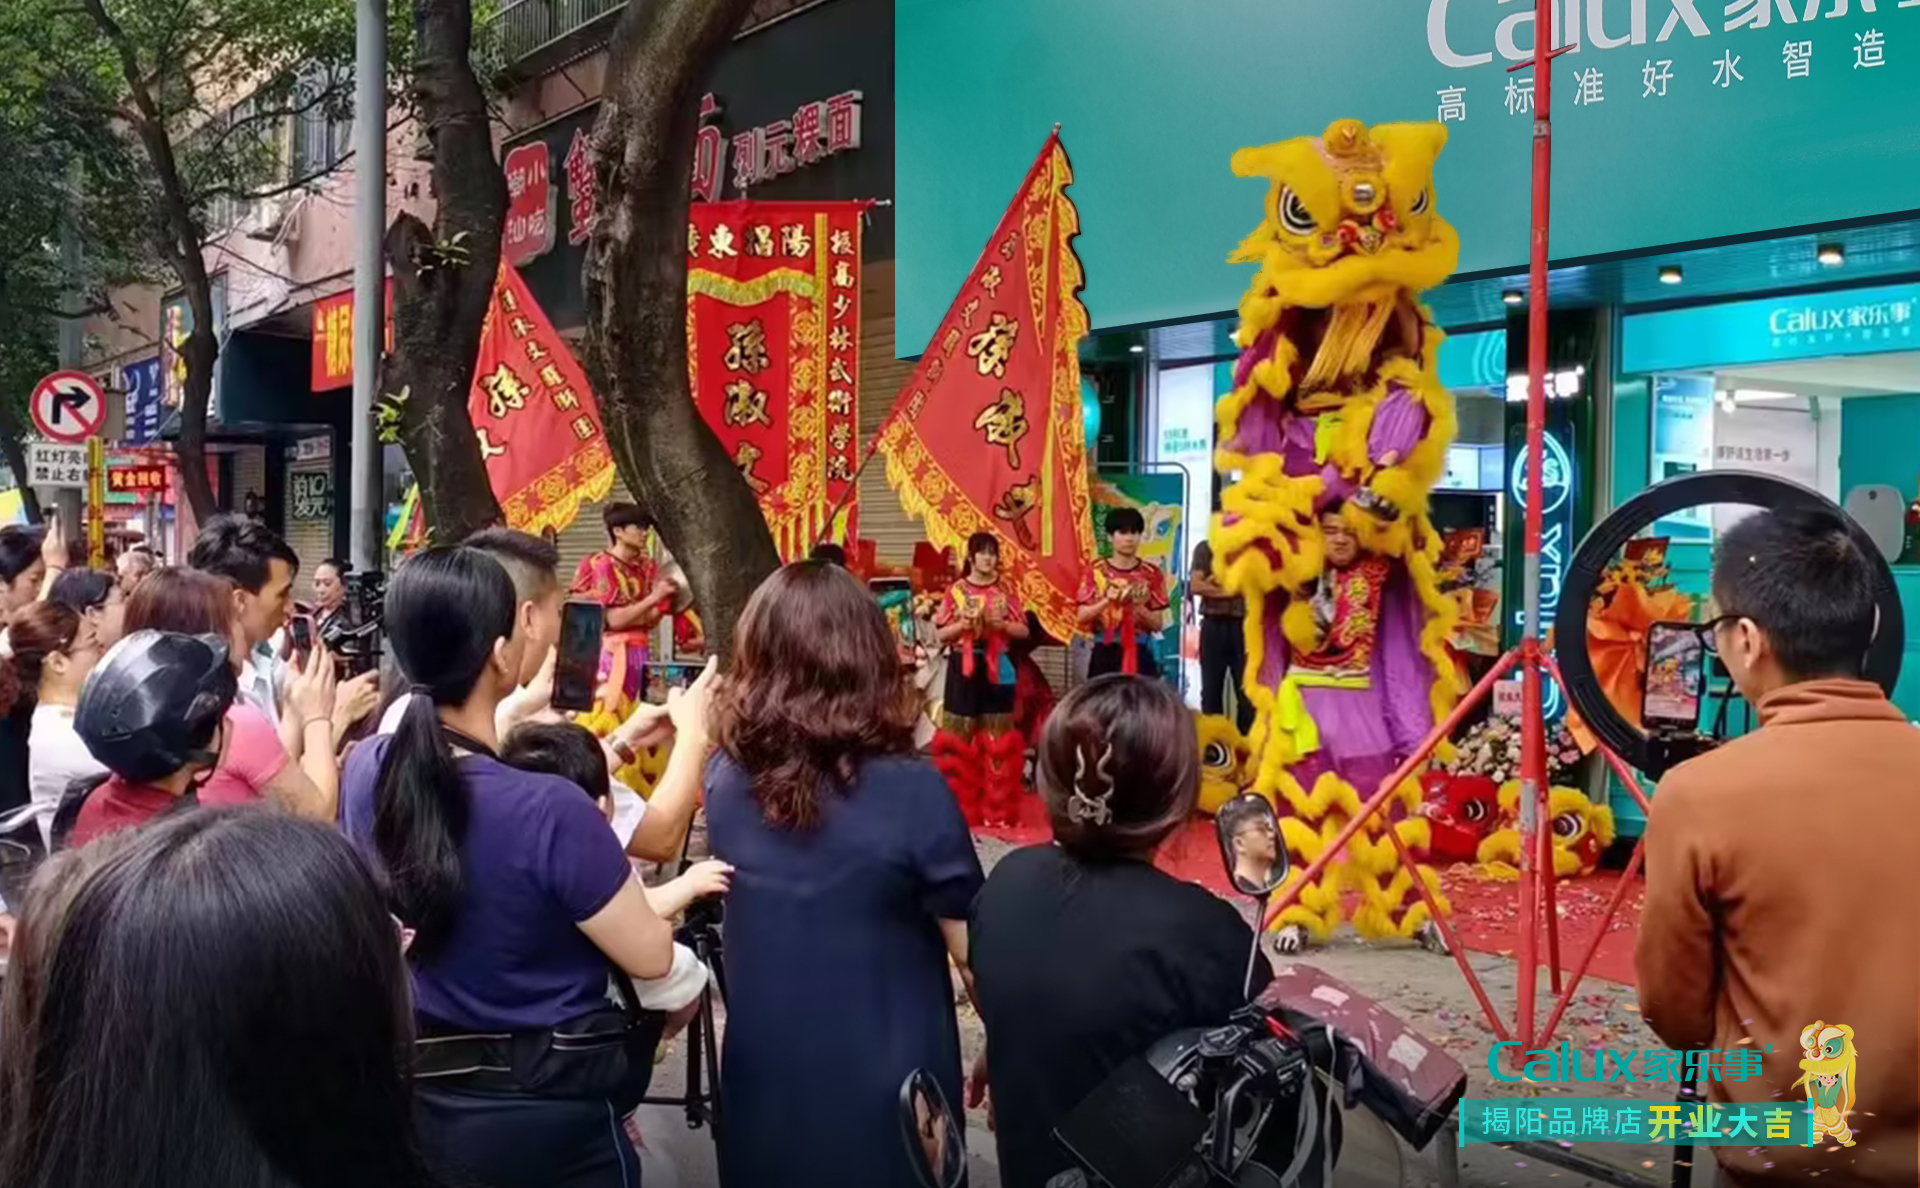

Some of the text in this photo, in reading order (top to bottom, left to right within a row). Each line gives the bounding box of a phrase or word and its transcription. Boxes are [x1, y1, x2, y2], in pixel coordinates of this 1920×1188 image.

[1436, 28, 1887, 123] 高标准好水智造
